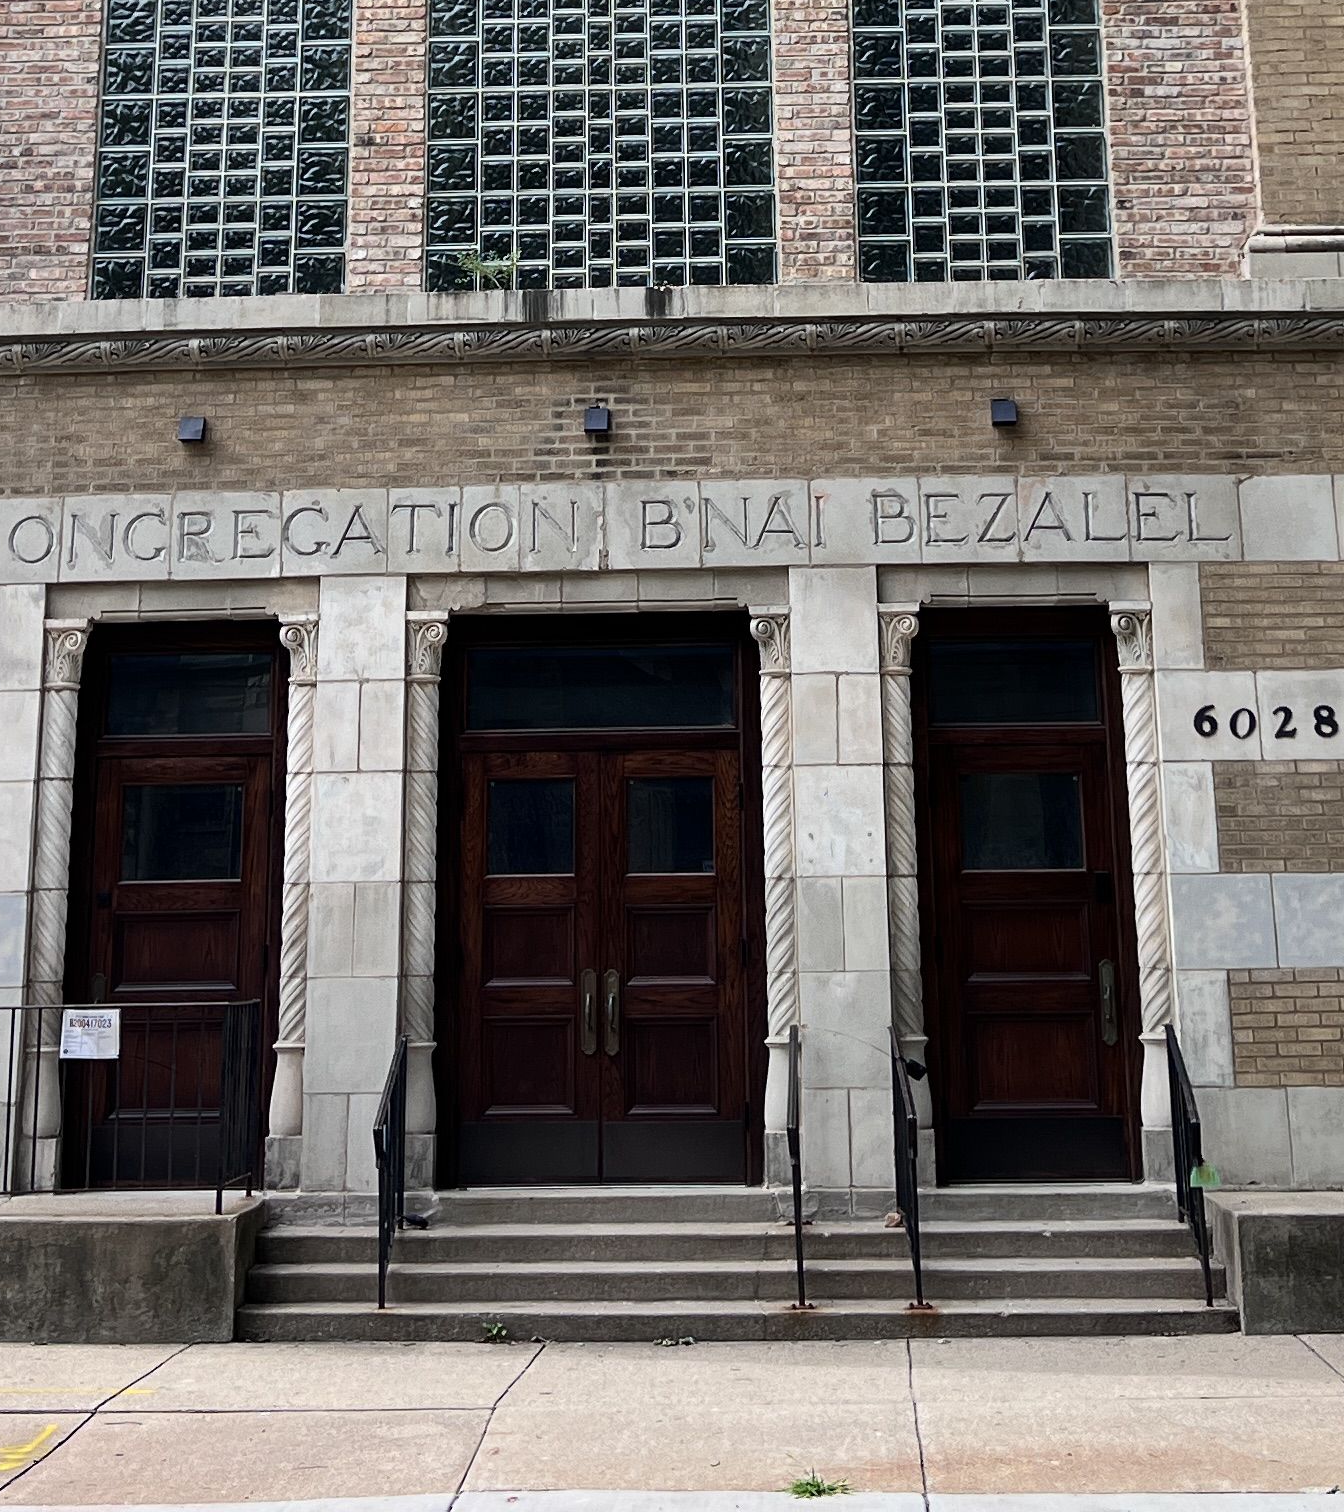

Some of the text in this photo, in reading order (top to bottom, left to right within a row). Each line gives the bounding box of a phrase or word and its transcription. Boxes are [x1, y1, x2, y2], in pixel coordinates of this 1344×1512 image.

[639, 493, 826, 552] B'NAI
[871, 487, 1234, 546] BEZALEL
[1193, 704, 1340, 740] 6028
